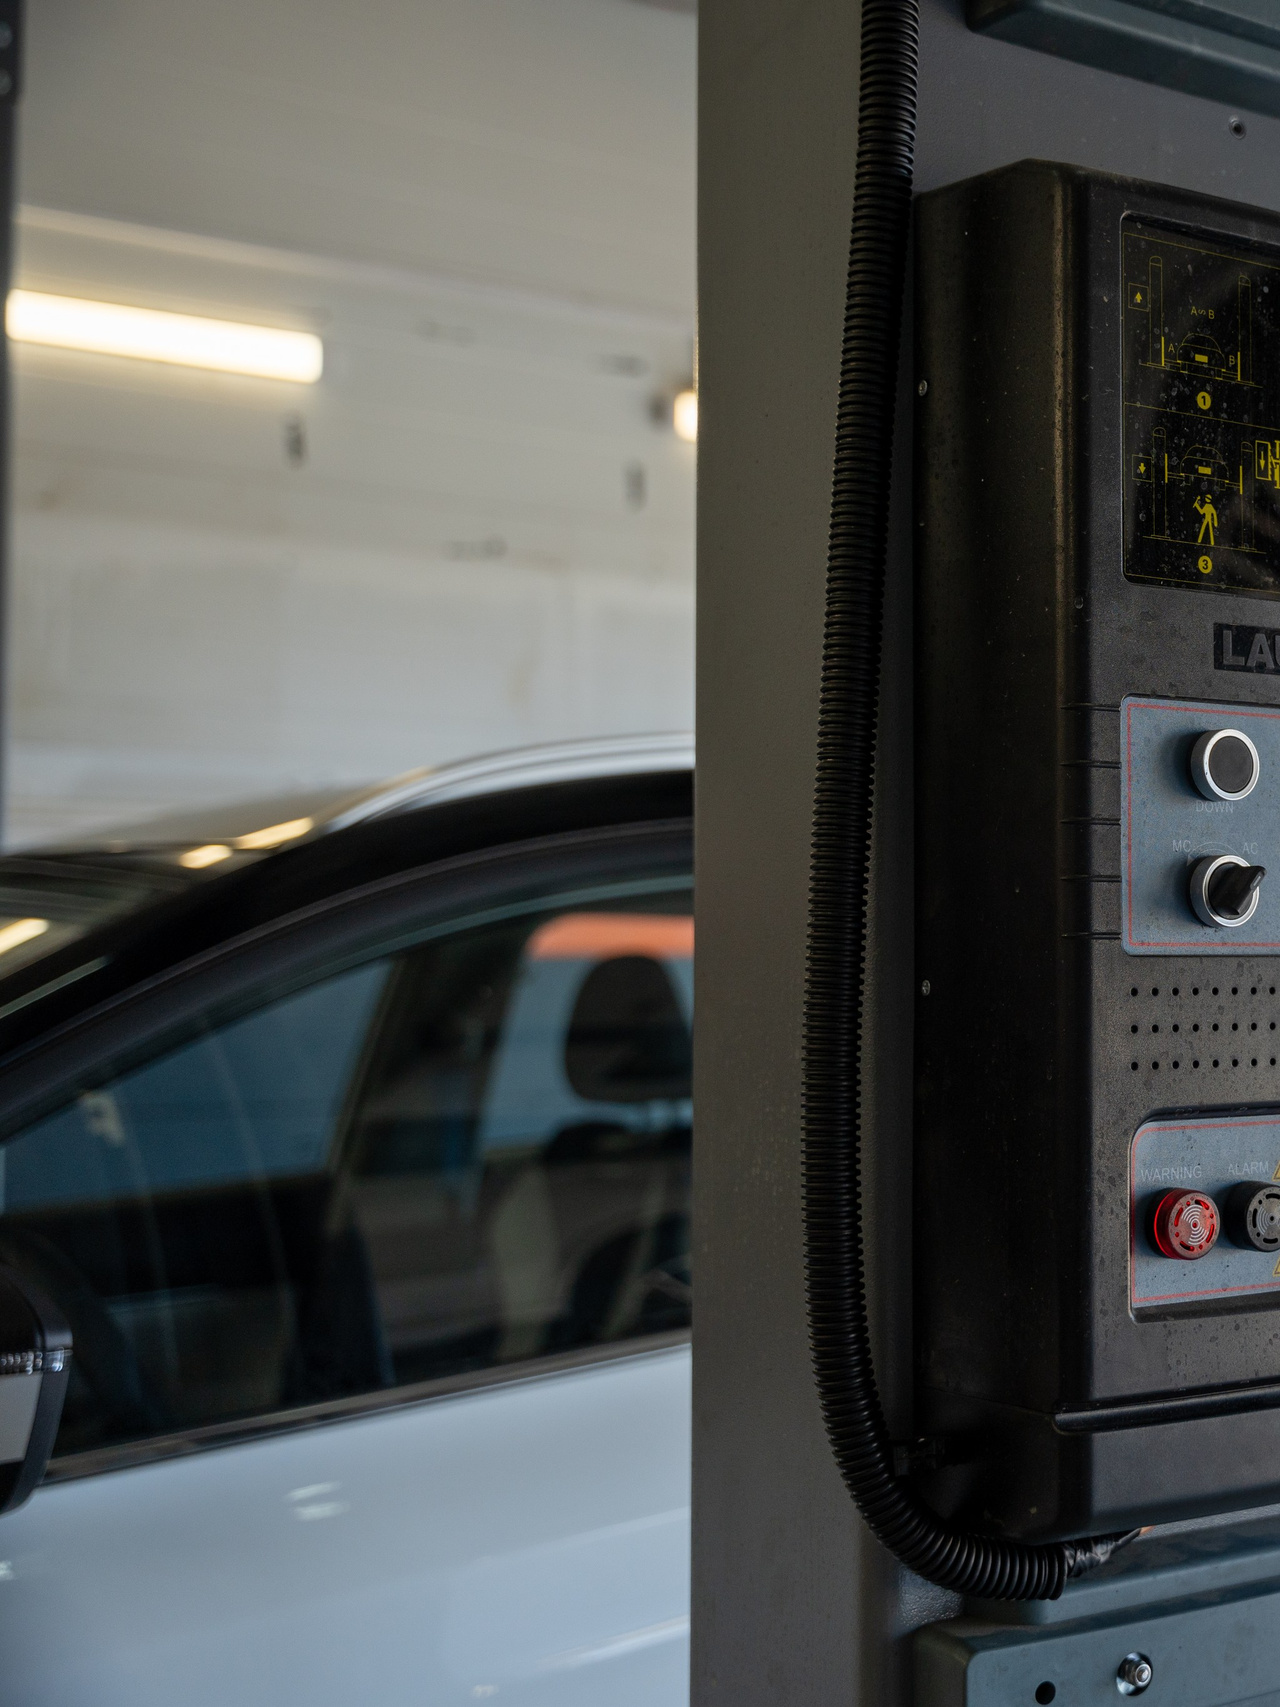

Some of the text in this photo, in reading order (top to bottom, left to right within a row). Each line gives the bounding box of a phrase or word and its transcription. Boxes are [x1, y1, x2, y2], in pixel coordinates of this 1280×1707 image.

[1195, 800, 1234, 814] DOWN
[1172, 840, 1191, 853] MC
[1242, 842, 1258, 855] AC
[1140, 1165, 1202, 1182] WARNING
[1227, 1161, 1270, 1176] ALARM
